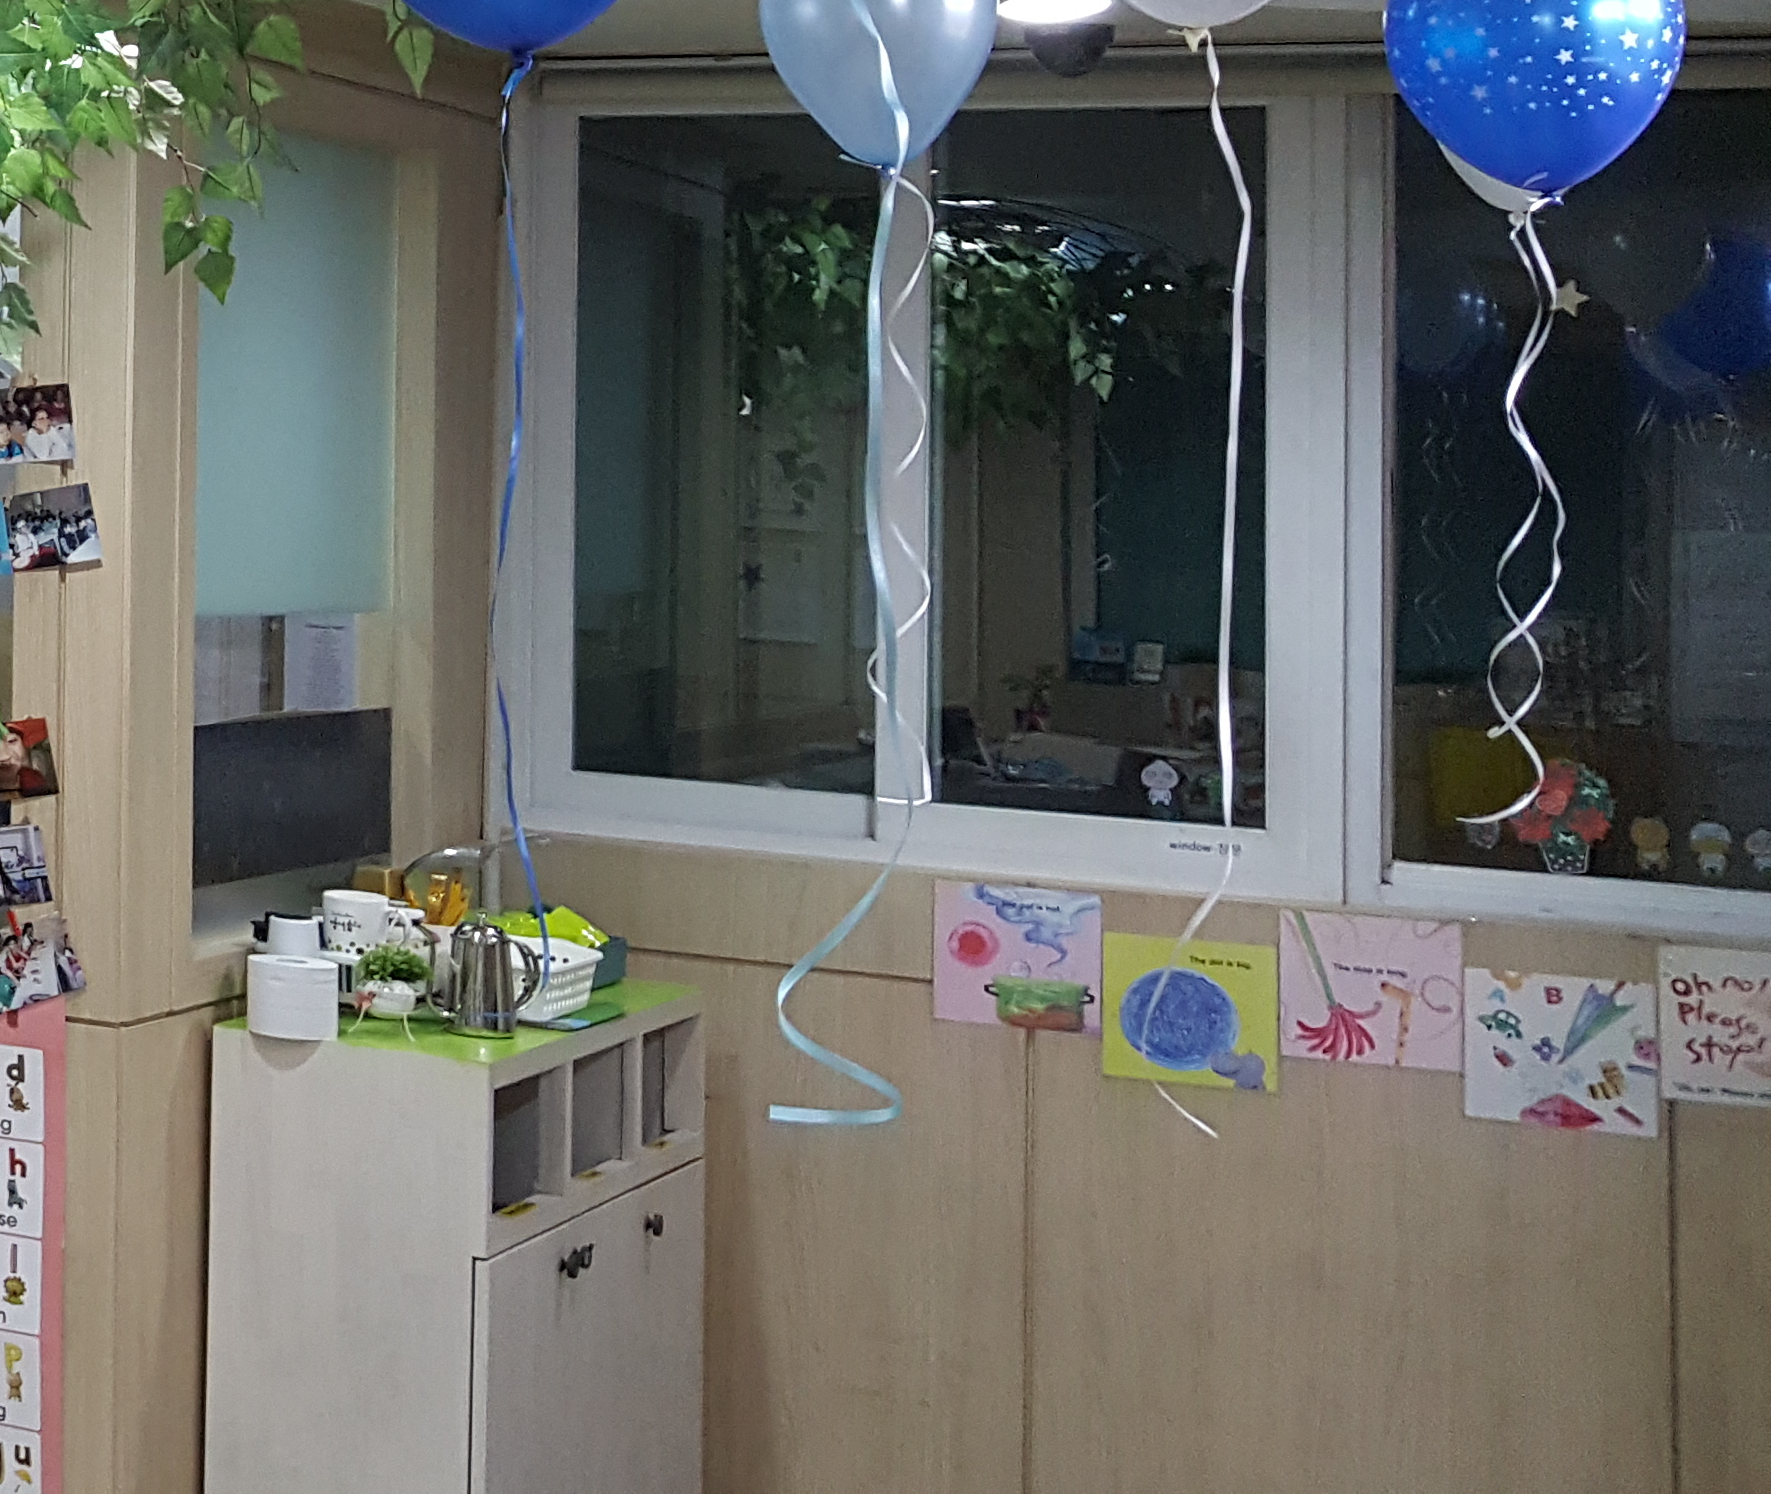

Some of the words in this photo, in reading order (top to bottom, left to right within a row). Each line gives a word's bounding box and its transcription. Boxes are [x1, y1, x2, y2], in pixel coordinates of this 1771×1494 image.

[1543, 985, 1564, 1006] B
[1671, 972, 1713, 997] Oh
[1677, 999, 1759, 1039] Please
[6, 1054, 25, 1084] d
[8, 1147, 28, 1179] h
[14, 1443, 33, 1468] u
